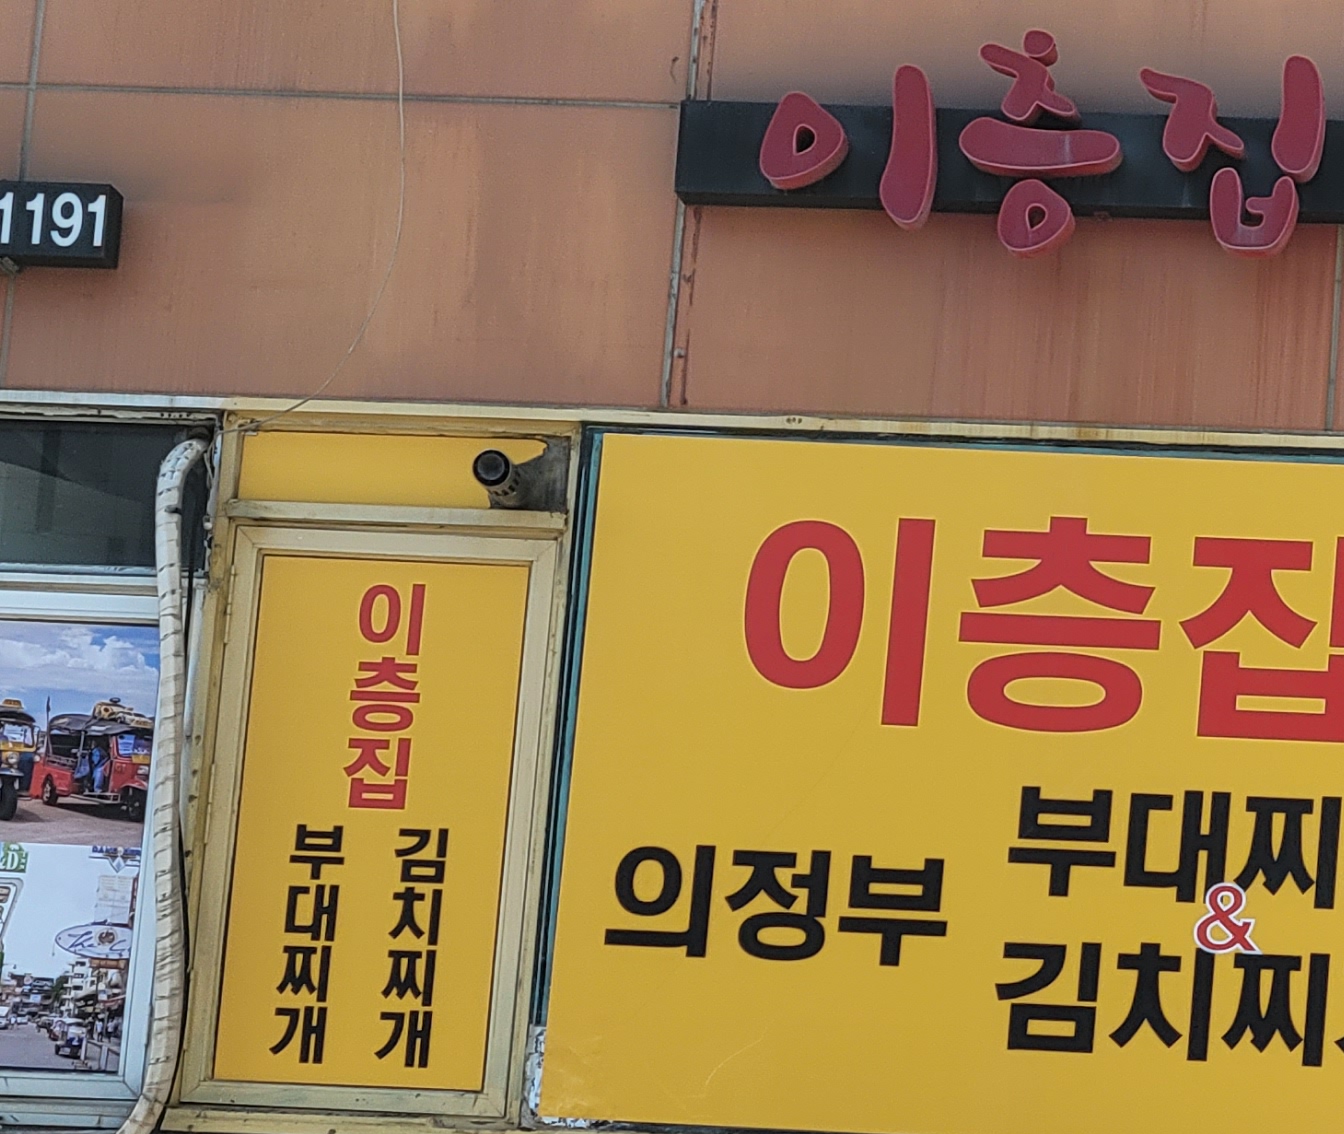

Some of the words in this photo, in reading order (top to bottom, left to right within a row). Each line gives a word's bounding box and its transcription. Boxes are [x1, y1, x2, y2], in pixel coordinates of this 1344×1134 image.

[0, 191, 107, 247] 1191
[759, 29, 1326, 258] 이층집
[343, 583, 426, 810] 이층집
[269, 824, 345, 1065] 부대찌개
[374, 828, 449, 1068] 김치찌개
[604, 845, 948, 967] 의정부
[1194, 881, 1262, 954] &
